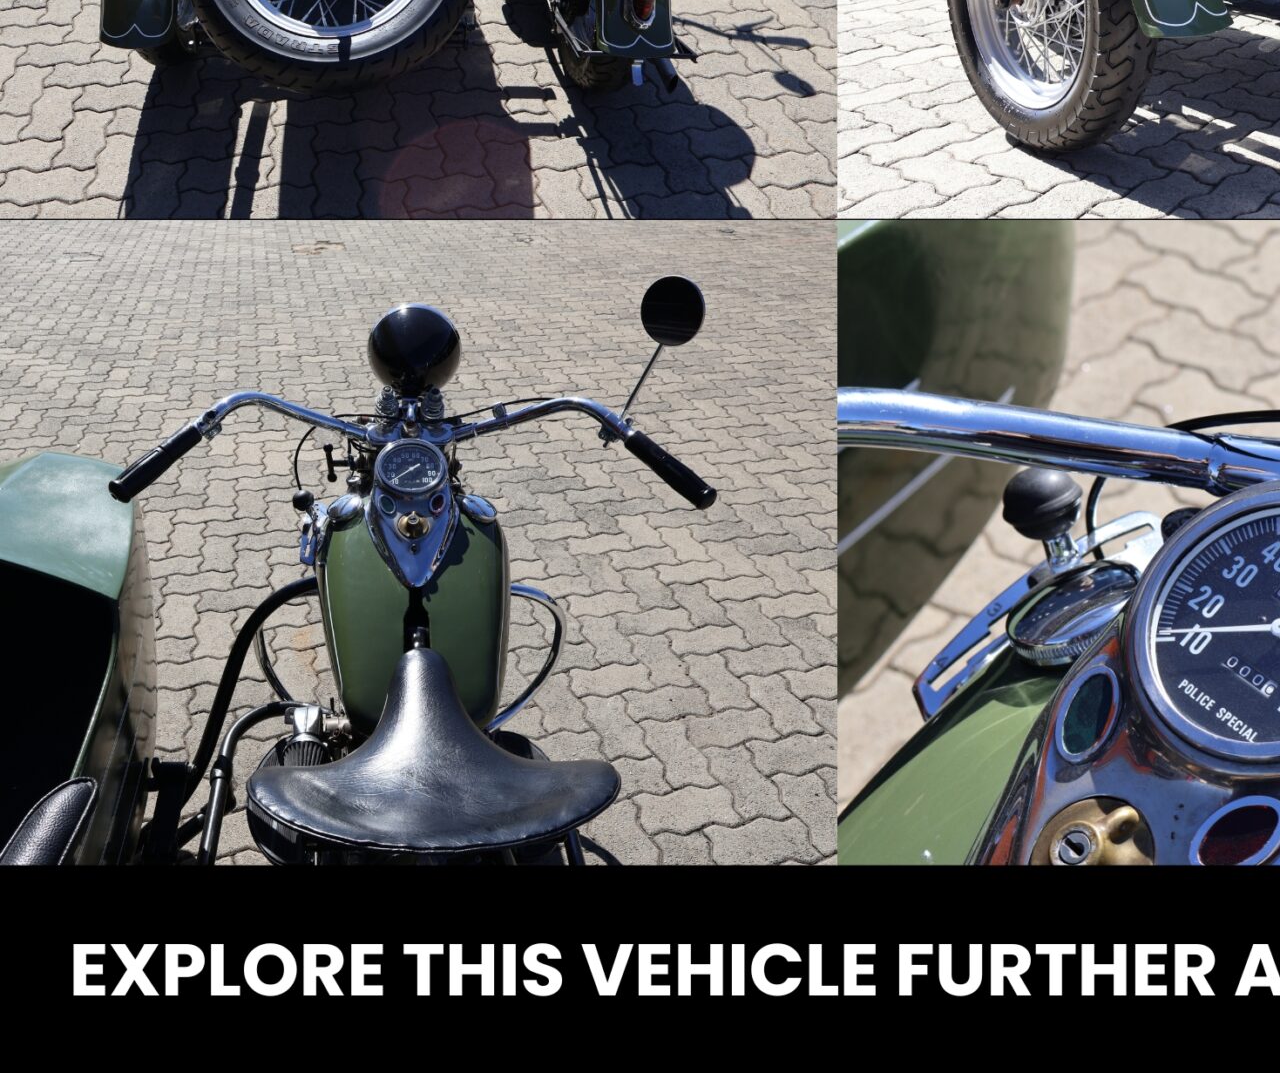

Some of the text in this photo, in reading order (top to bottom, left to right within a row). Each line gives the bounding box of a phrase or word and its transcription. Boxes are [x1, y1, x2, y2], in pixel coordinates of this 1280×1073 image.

[1222, 556, 1259, 588] 30
[1187, 585, 1225, 619] 20
[1179, 624, 1212, 655] 10
[1178, 678, 1259, 743] POLICE SPECIAL
